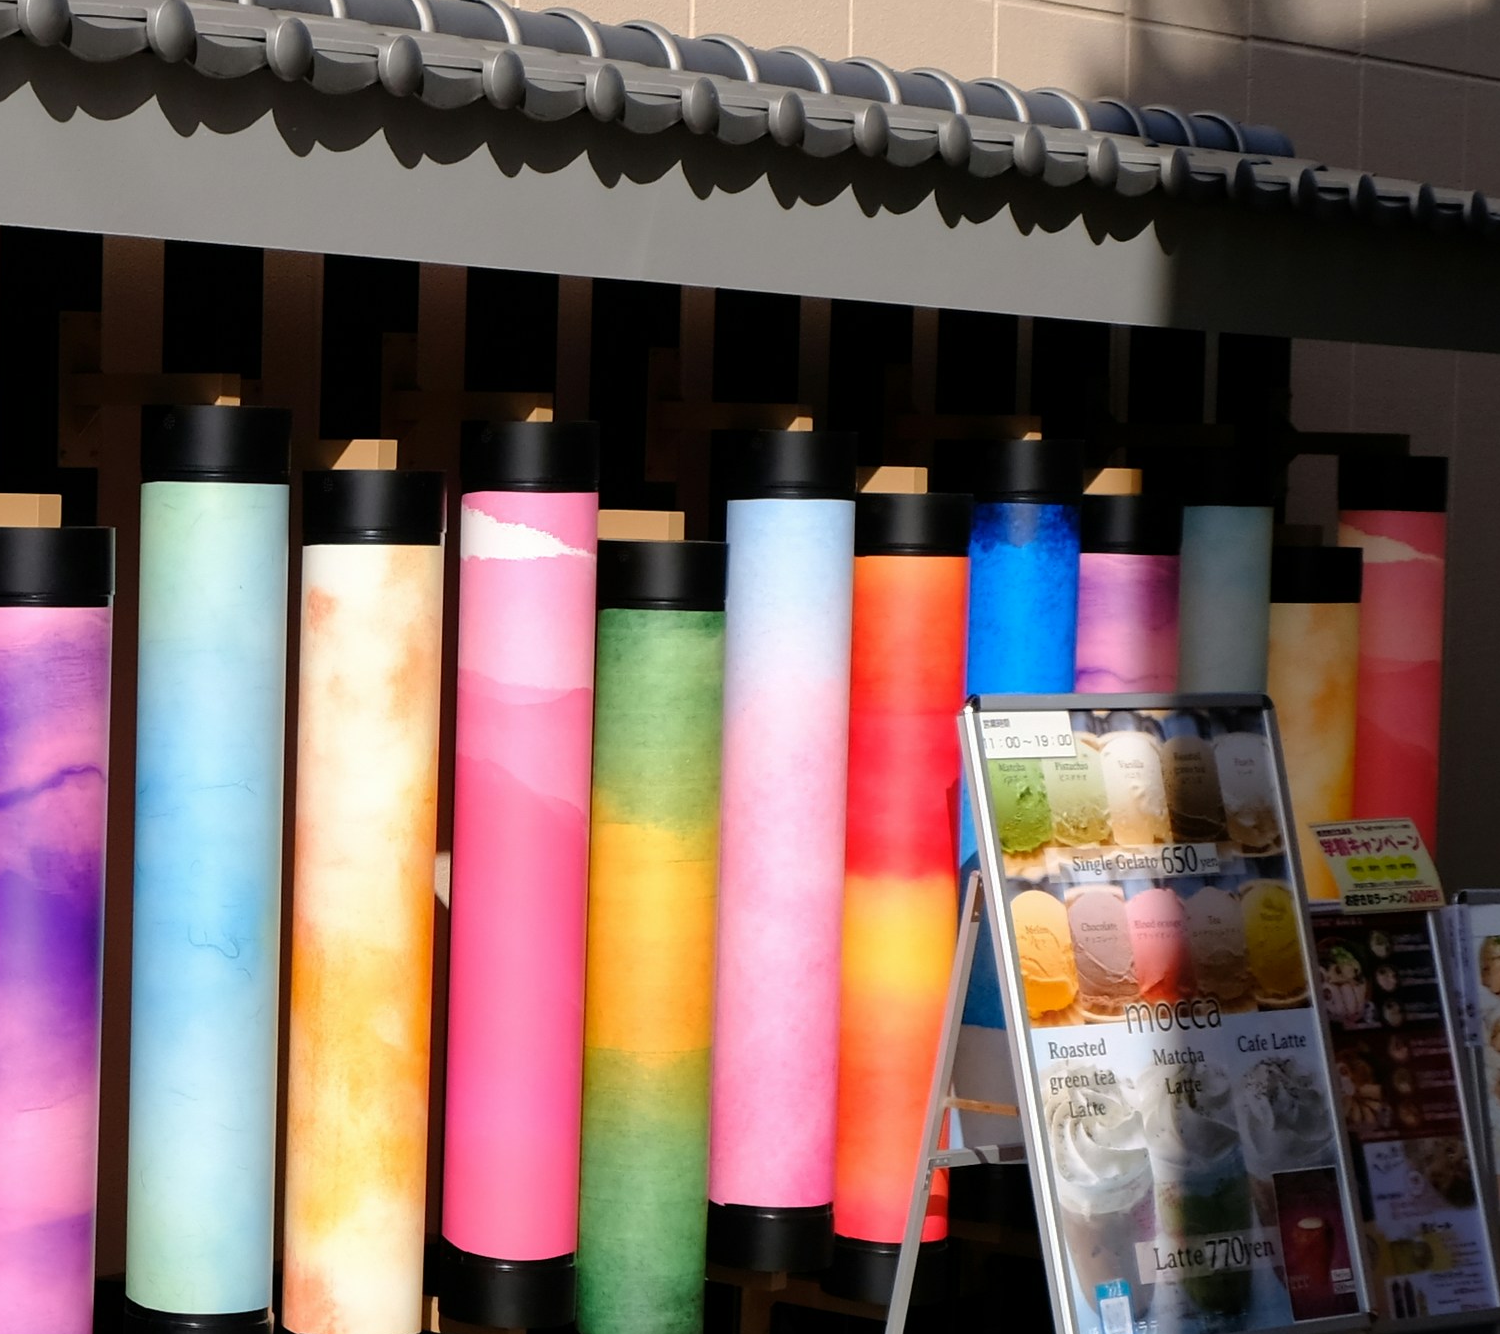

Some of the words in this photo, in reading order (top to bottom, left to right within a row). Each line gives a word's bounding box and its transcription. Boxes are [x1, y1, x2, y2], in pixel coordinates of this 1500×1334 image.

[1072, 855, 1112, 877] Single
[1115, 853, 1159, 873] Gelato
[1161, 845, 1197, 875] 650
[1124, 994, 1223, 1034] mocca
[1047, 1038, 1107, 1060] Roasted
[1237, 1034, 1268, 1053] Cafe
[1271, 1032, 1307, 1050] Latte
[1152, 1046, 1206, 1067] Matcha
[1050, 1072, 1090, 1095] green
[1093, 1071, 1116, 1087] tea
[1165, 1076, 1203, 1095] Latte
[1069, 1099, 1106, 1120] Latte
